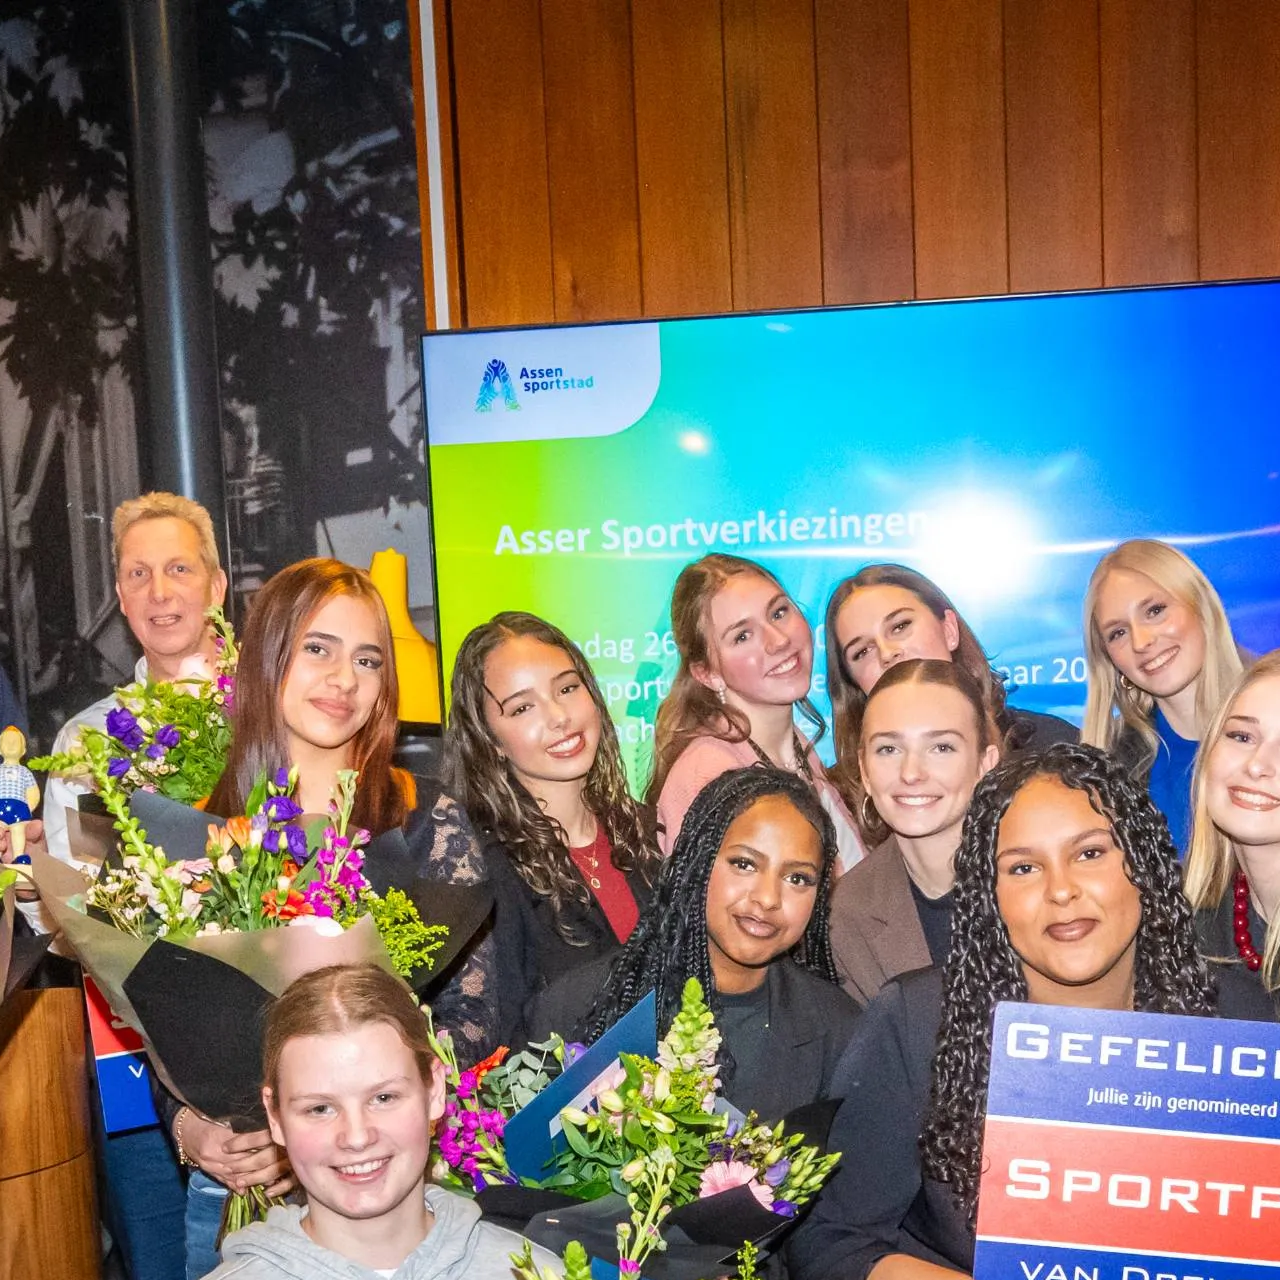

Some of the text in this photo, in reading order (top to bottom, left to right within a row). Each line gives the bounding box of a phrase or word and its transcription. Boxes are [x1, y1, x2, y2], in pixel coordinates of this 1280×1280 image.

[519, 367, 563, 379] Assen
[523, 376, 595, 393] sportstad
[494, 507, 928, 557] Asser Sportverkiezingen
[1085, 1082, 1129, 1107] Jullie
[1133, 1091, 1163, 1111] zijn
[1166, 1097, 1278, 1118] genomineerd
